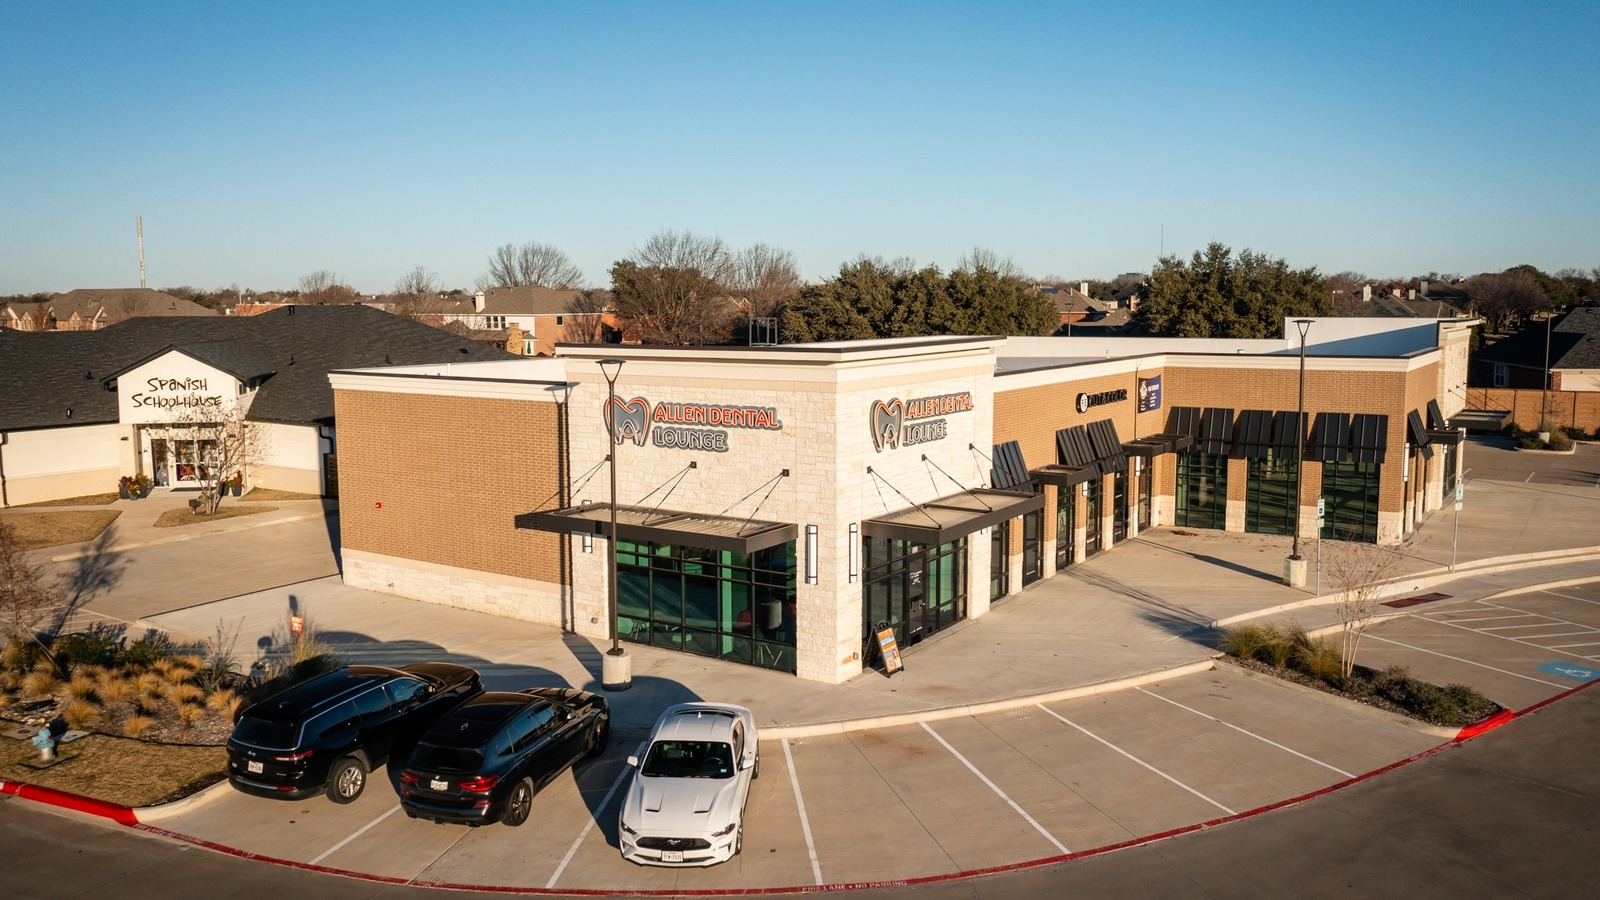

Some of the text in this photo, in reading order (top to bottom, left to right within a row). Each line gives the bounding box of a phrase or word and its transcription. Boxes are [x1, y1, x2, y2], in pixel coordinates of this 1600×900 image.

[654, 403, 779, 428] ALLEN DENTAL
[907, 394, 974, 418] ALLEN DENTAL
[654, 428, 727, 450] LOUNGE
[906, 421, 948, 444] LOUNGE
[869, 880, 907, 888] PARKING
